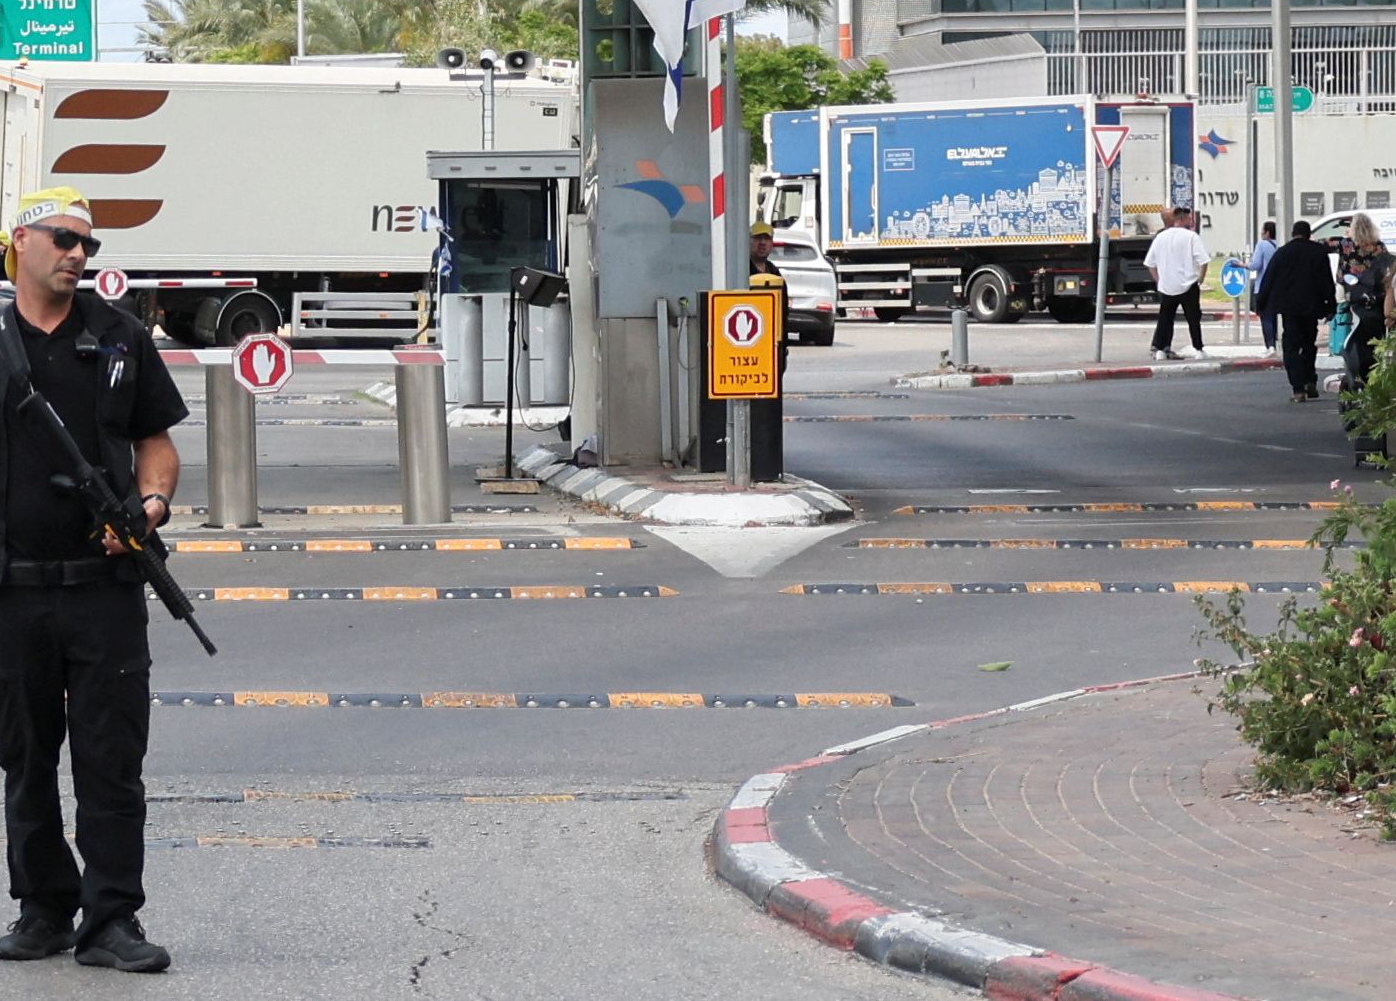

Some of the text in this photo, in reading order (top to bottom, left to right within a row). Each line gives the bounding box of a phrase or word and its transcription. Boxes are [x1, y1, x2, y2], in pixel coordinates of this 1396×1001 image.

[12, 41, 84, 55] Terminal
[729, 356, 759, 366] עצור
[719, 372, 769, 385] לביקורת
